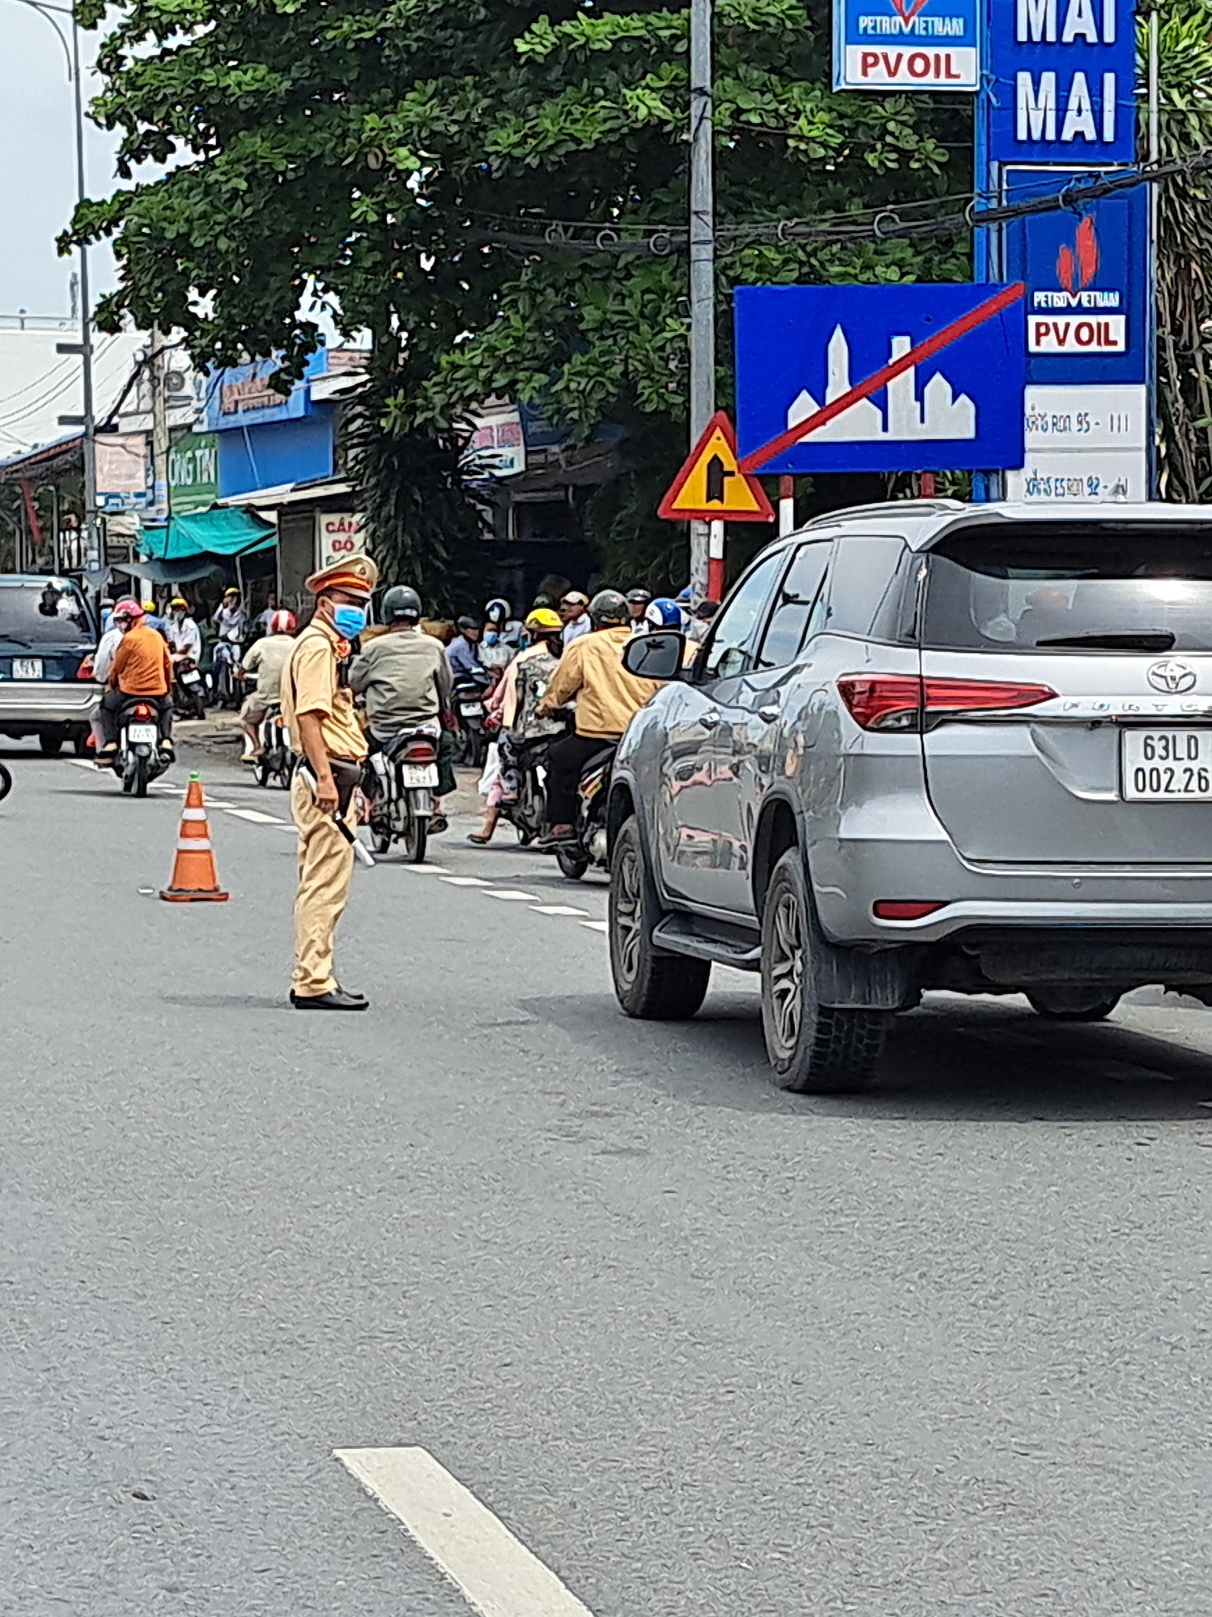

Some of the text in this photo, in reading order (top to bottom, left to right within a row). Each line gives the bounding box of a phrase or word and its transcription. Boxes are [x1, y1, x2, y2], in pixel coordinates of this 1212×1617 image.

[858, 15, 964, 36] PETROVIETNAM
[1016, 0, 1116, 43] MAI
[1016, 71, 1116, 142] MAI
[1143, 734, 1199, 761] 63LD
[1134, 767, 1210, 793] 002.26
